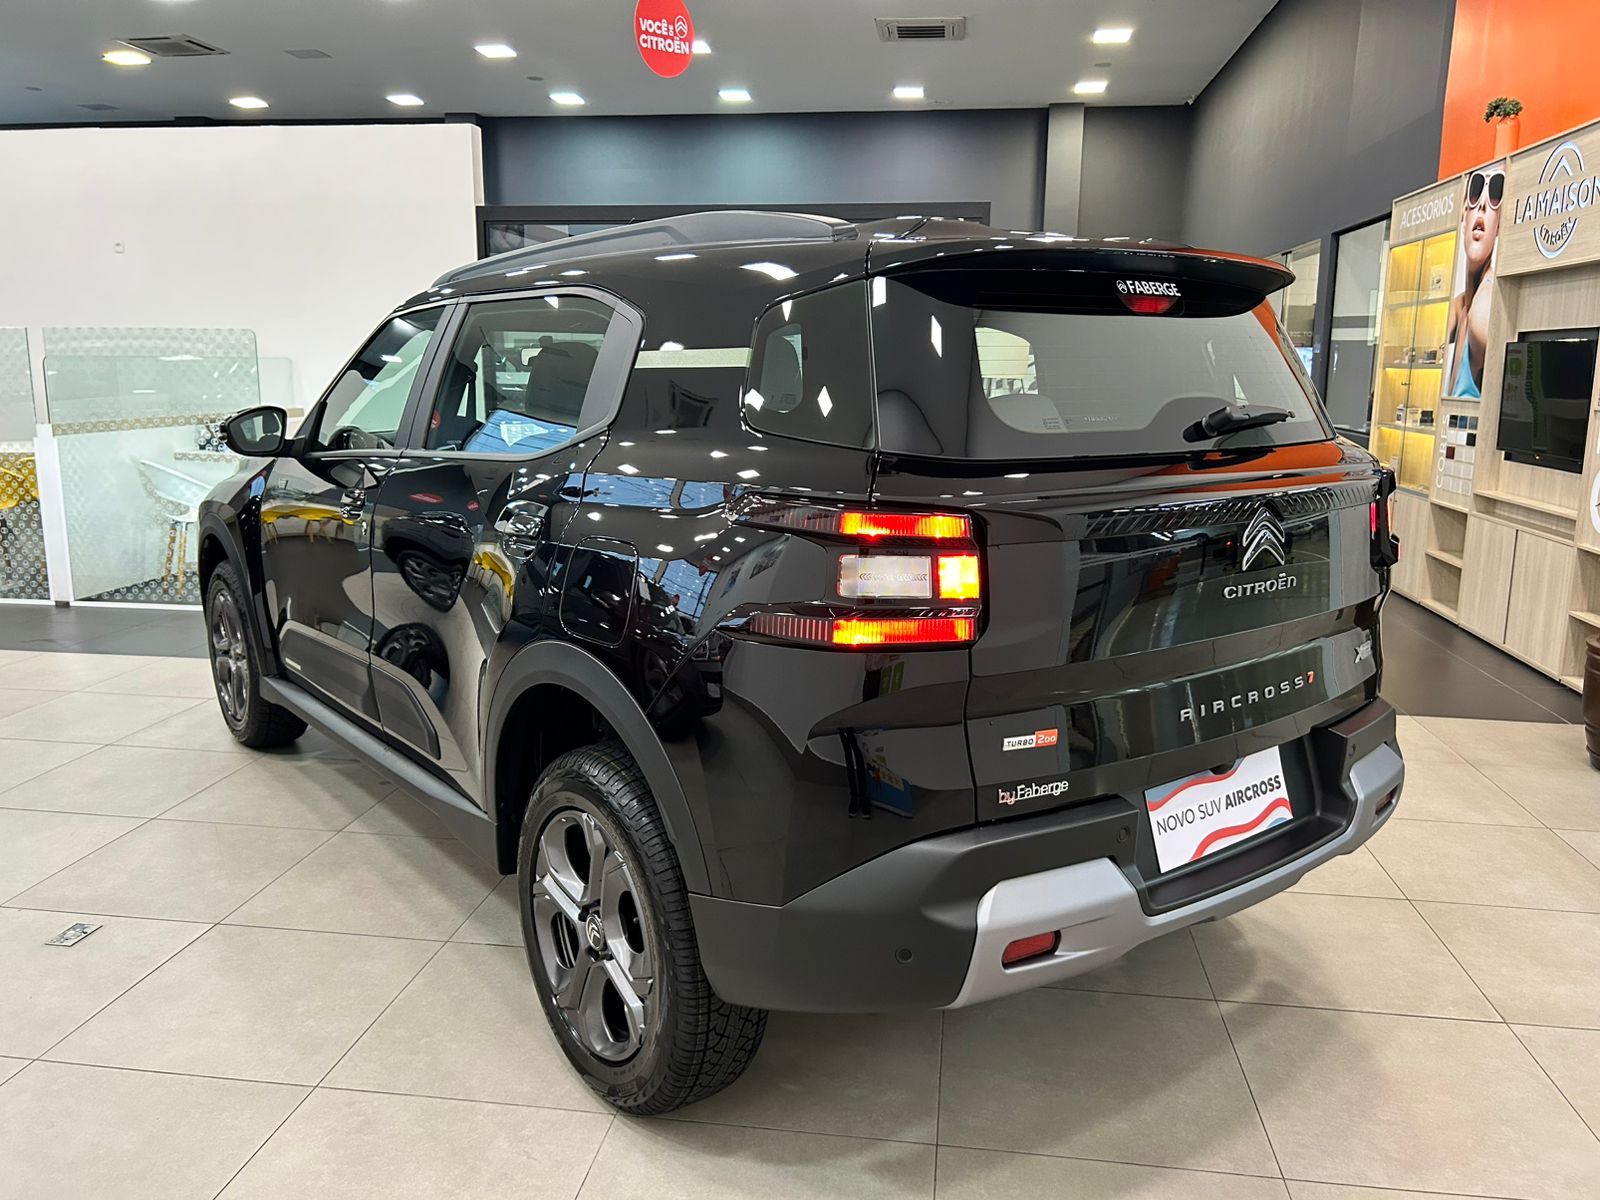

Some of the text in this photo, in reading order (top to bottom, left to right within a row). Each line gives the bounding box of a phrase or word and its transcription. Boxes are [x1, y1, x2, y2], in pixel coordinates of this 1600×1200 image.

[639, 17, 668, 36] VOCÊ
[639, 35, 690, 55] CITROËN
[1126, 280, 1181, 297] FABERGE
[1435, 413, 1450, 488] CORES
[1006, 738, 1034, 747] TURBO
[1156, 774, 1282, 836] NOVO SUV AIRCROSS
